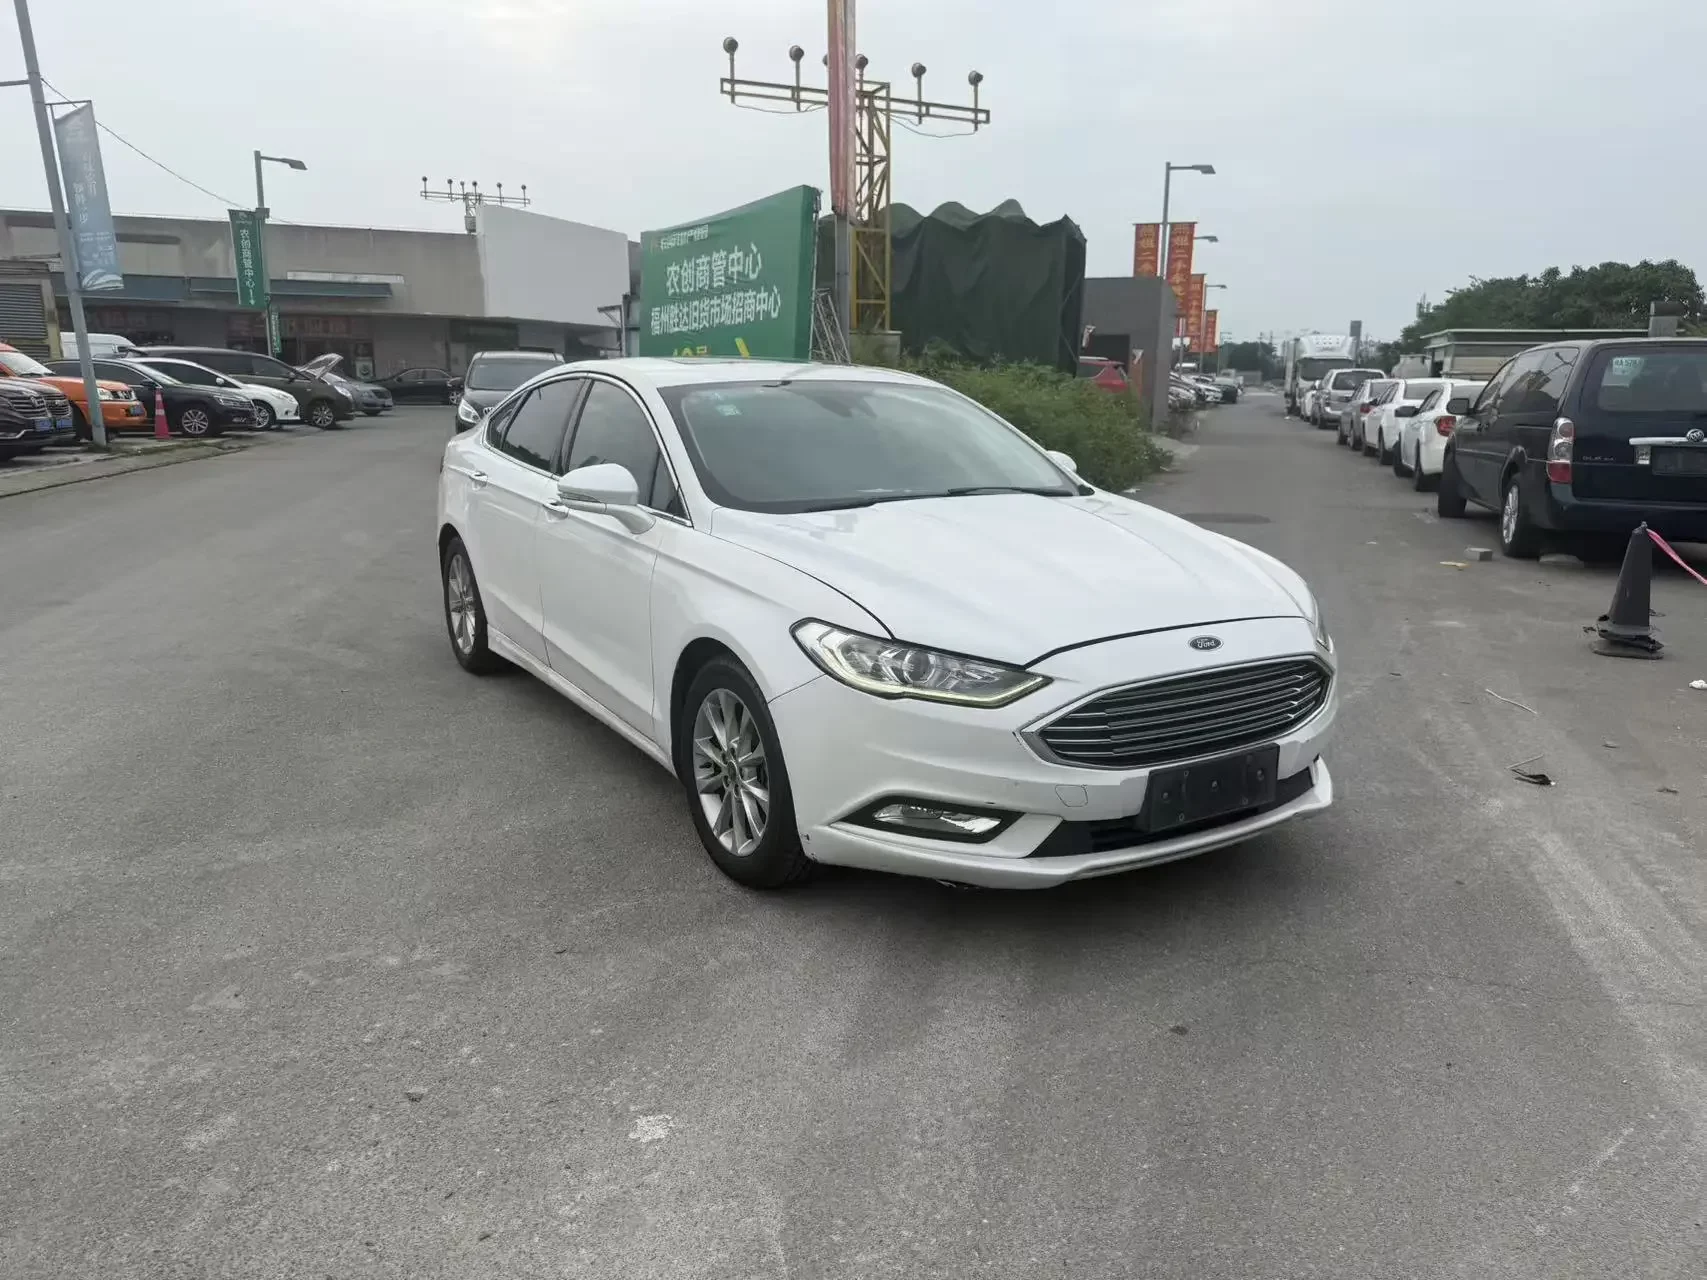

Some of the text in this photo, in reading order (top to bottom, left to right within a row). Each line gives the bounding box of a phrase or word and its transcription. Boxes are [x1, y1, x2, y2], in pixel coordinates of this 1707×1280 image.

[666, 241, 762, 296] 农创商管中心
[1194, 637, 1218, 649] Ford
